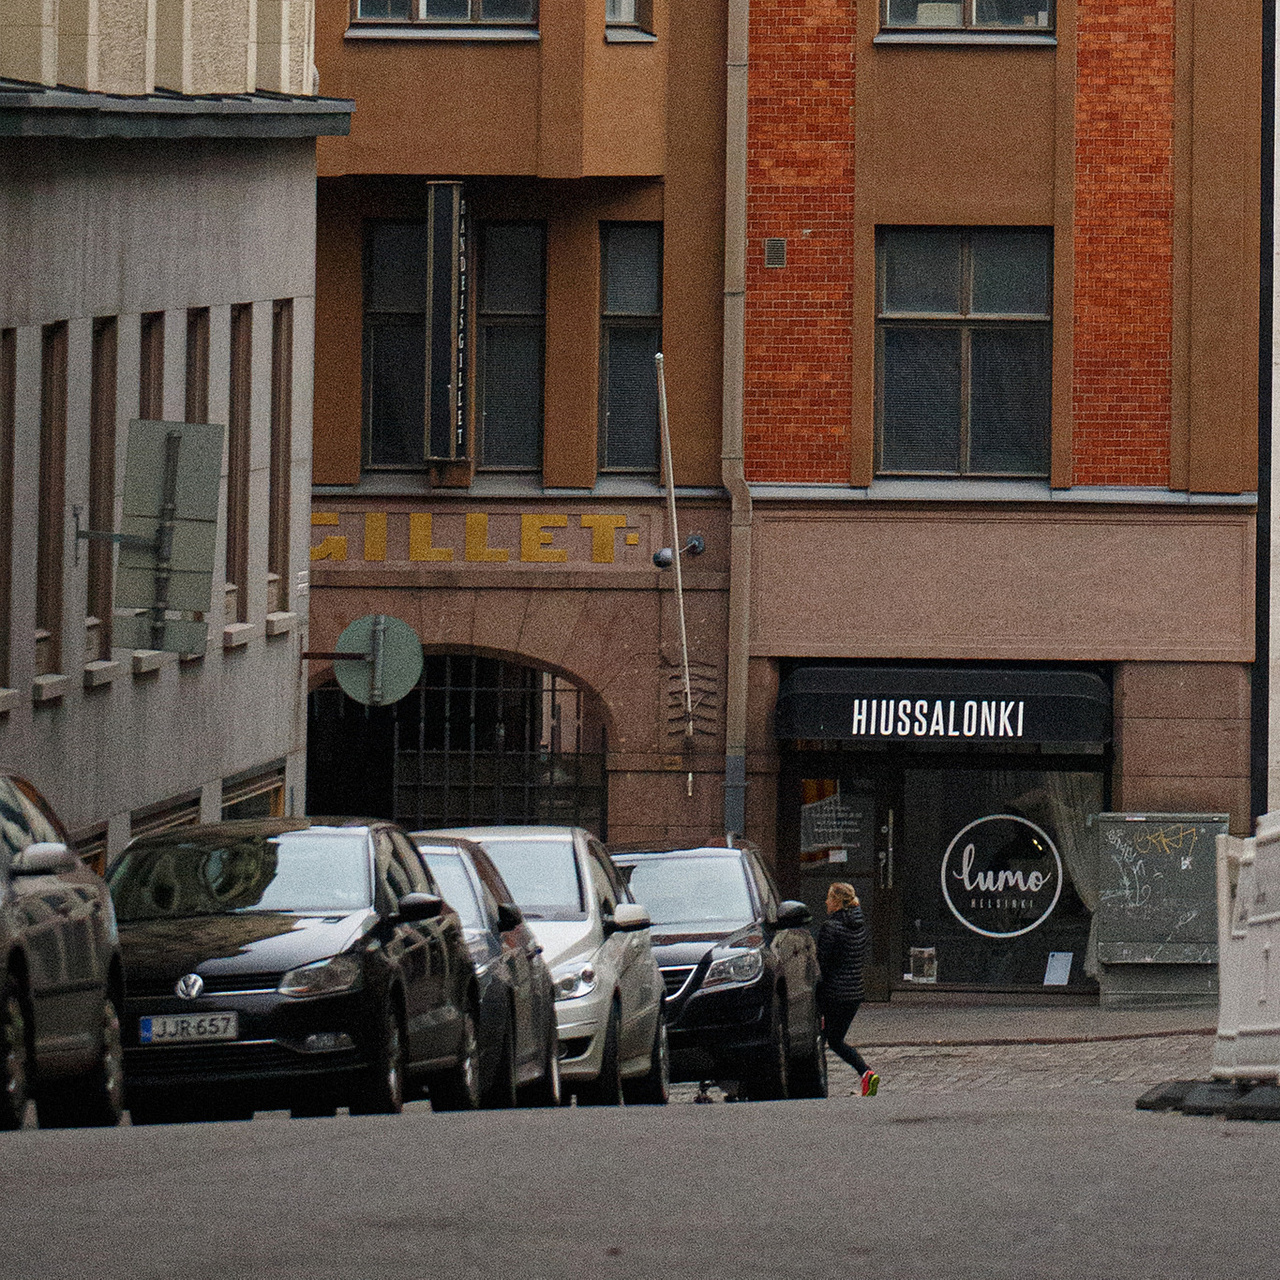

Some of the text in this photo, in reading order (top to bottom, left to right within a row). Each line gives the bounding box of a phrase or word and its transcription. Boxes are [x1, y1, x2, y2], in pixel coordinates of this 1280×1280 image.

[852, 698, 1025, 738] HIUSSALONKI
[952, 843, 1051, 892] lumo
[970, 898, 1034, 909] HELSINKI
[156, 1017, 231, 1038] JJR-657
